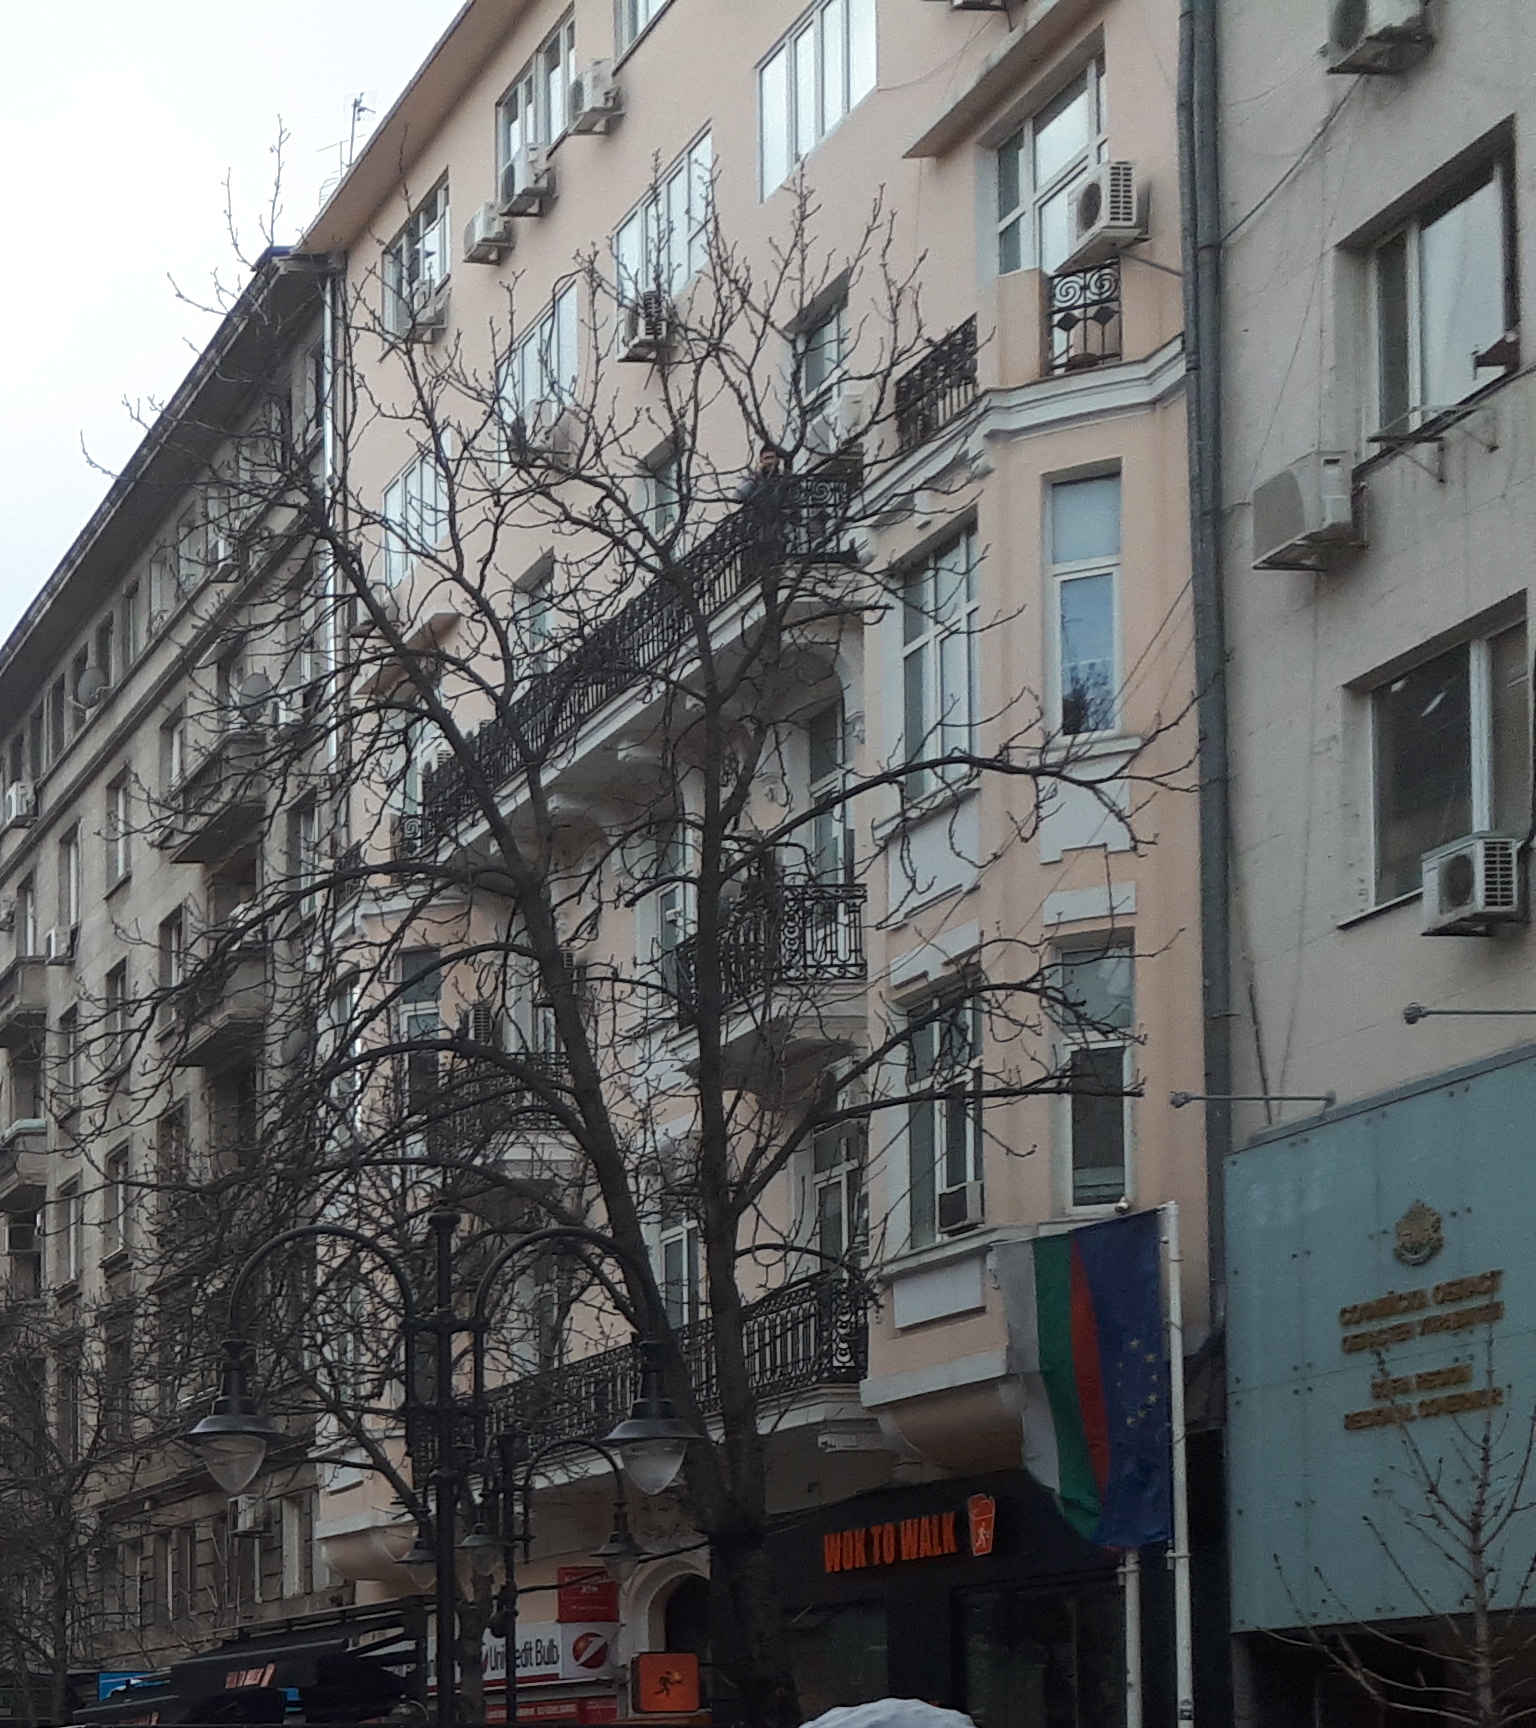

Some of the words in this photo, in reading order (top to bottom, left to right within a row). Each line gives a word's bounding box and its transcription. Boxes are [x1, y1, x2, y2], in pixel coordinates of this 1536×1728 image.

[824, 1527, 868, 1573] WOK
[870, 1522, 895, 1566] TO
[901, 1510, 957, 1561] WALK
[489, 1640, 533, 1672] Uniedit
